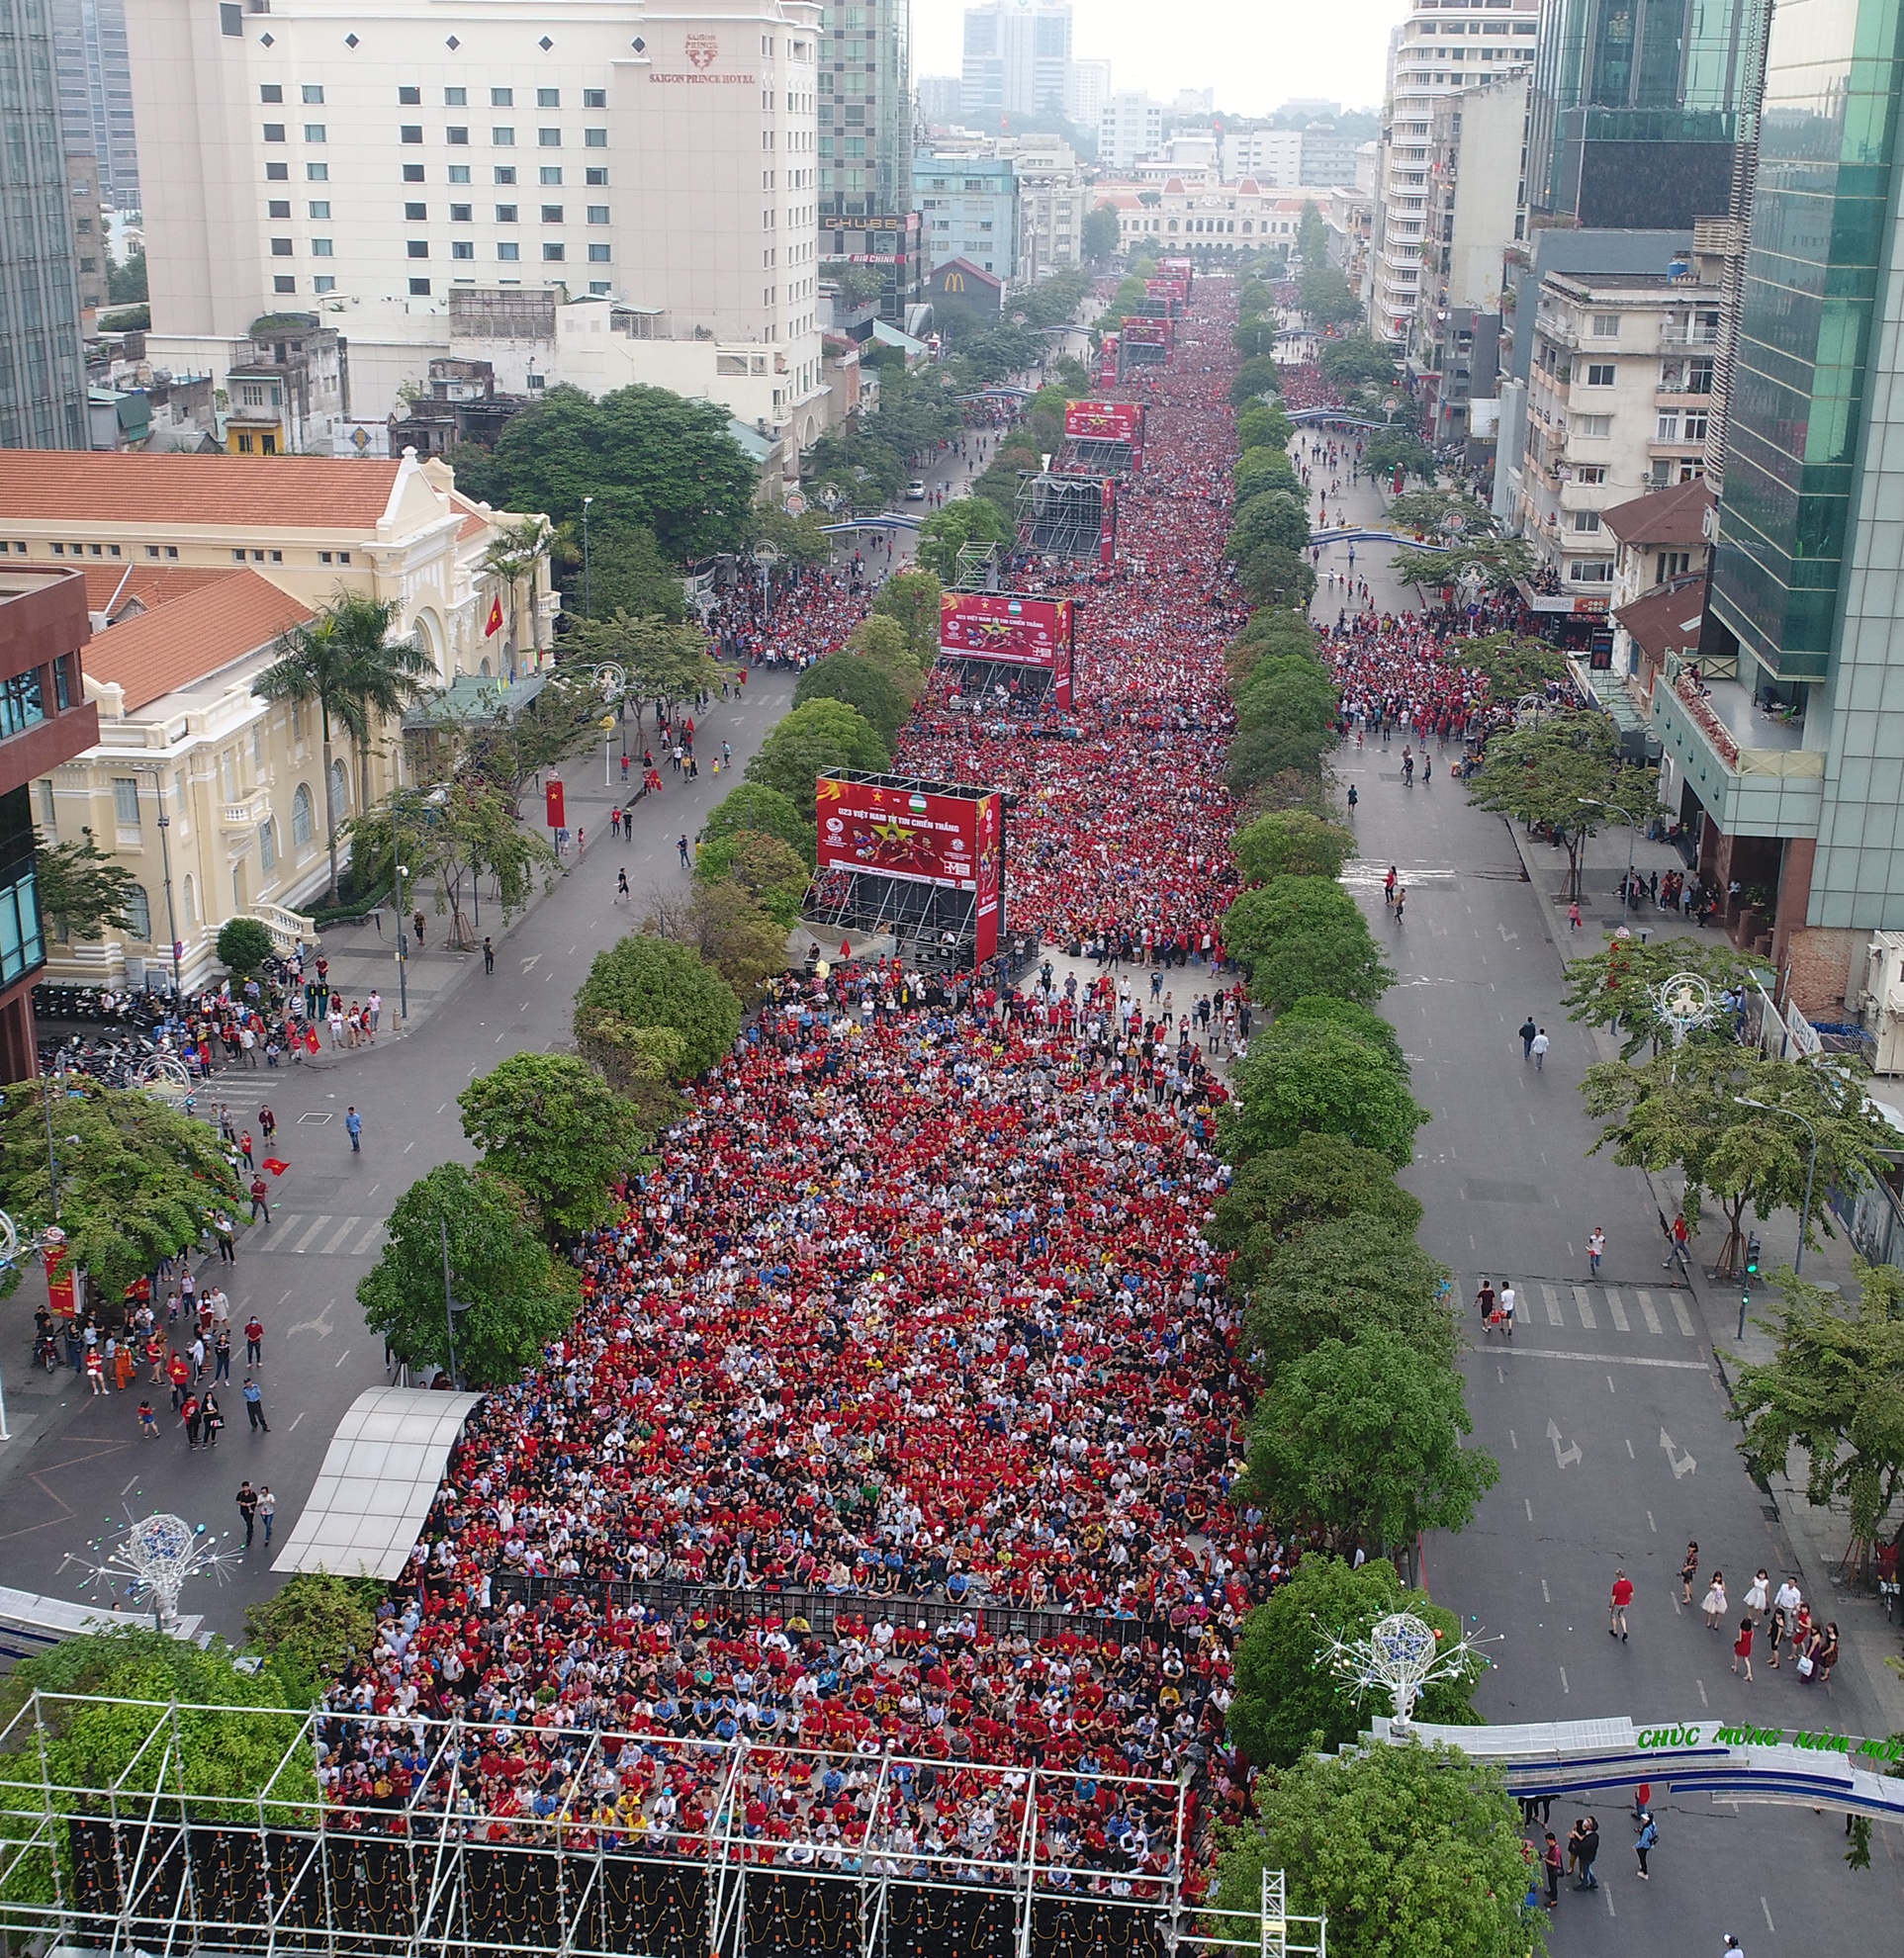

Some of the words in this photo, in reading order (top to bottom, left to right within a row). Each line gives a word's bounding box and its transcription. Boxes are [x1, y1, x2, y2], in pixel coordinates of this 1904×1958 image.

[649, 73, 684, 83] SAIGON
[686, 74, 721, 84] PRINCE
[722, 74, 755, 84] HOTEL
[825, 218, 897, 228] CHUBB
[853, 254, 868, 263] AIR
[869, 254, 895, 264] CHINA
[838, 807, 853, 817] U23
[854, 810, 868, 820] VIỆT
[869, 813, 887, 822] NAM
